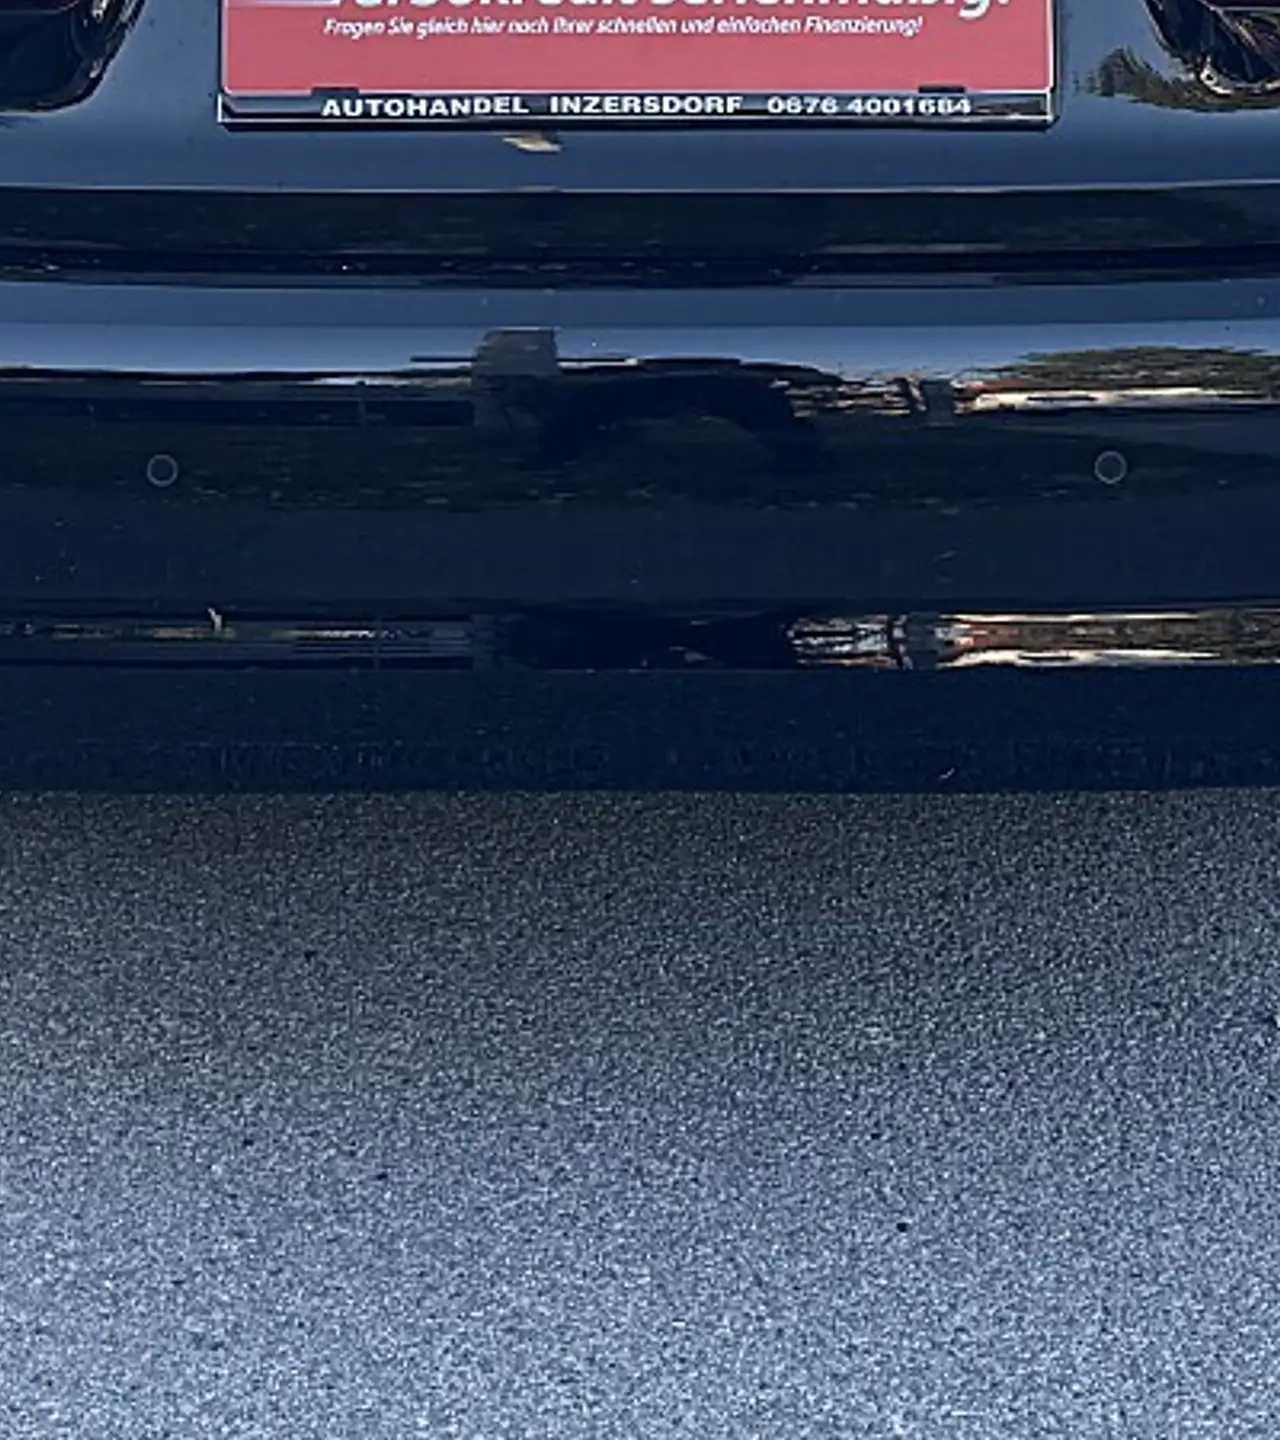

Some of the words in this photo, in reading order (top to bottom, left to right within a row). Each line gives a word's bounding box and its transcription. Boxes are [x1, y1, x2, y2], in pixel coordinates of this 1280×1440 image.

[323, 16, 384, 40] Fragen
[388, 16, 414, 35] Sie
[416, 17, 468, 40] gleich
[471, 16, 504, 34] hier
[508, 16, 548, 34] nach
[597, 16, 677, 34] schnellen
[681, 16, 715, 34] und
[718, 16, 801, 34] einfachen
[804, 16, 924, 37] Finanzierung!
[321, 96, 529, 117] AUTOHANDEL
[550, 95, 744, 114] INZERSDORF
